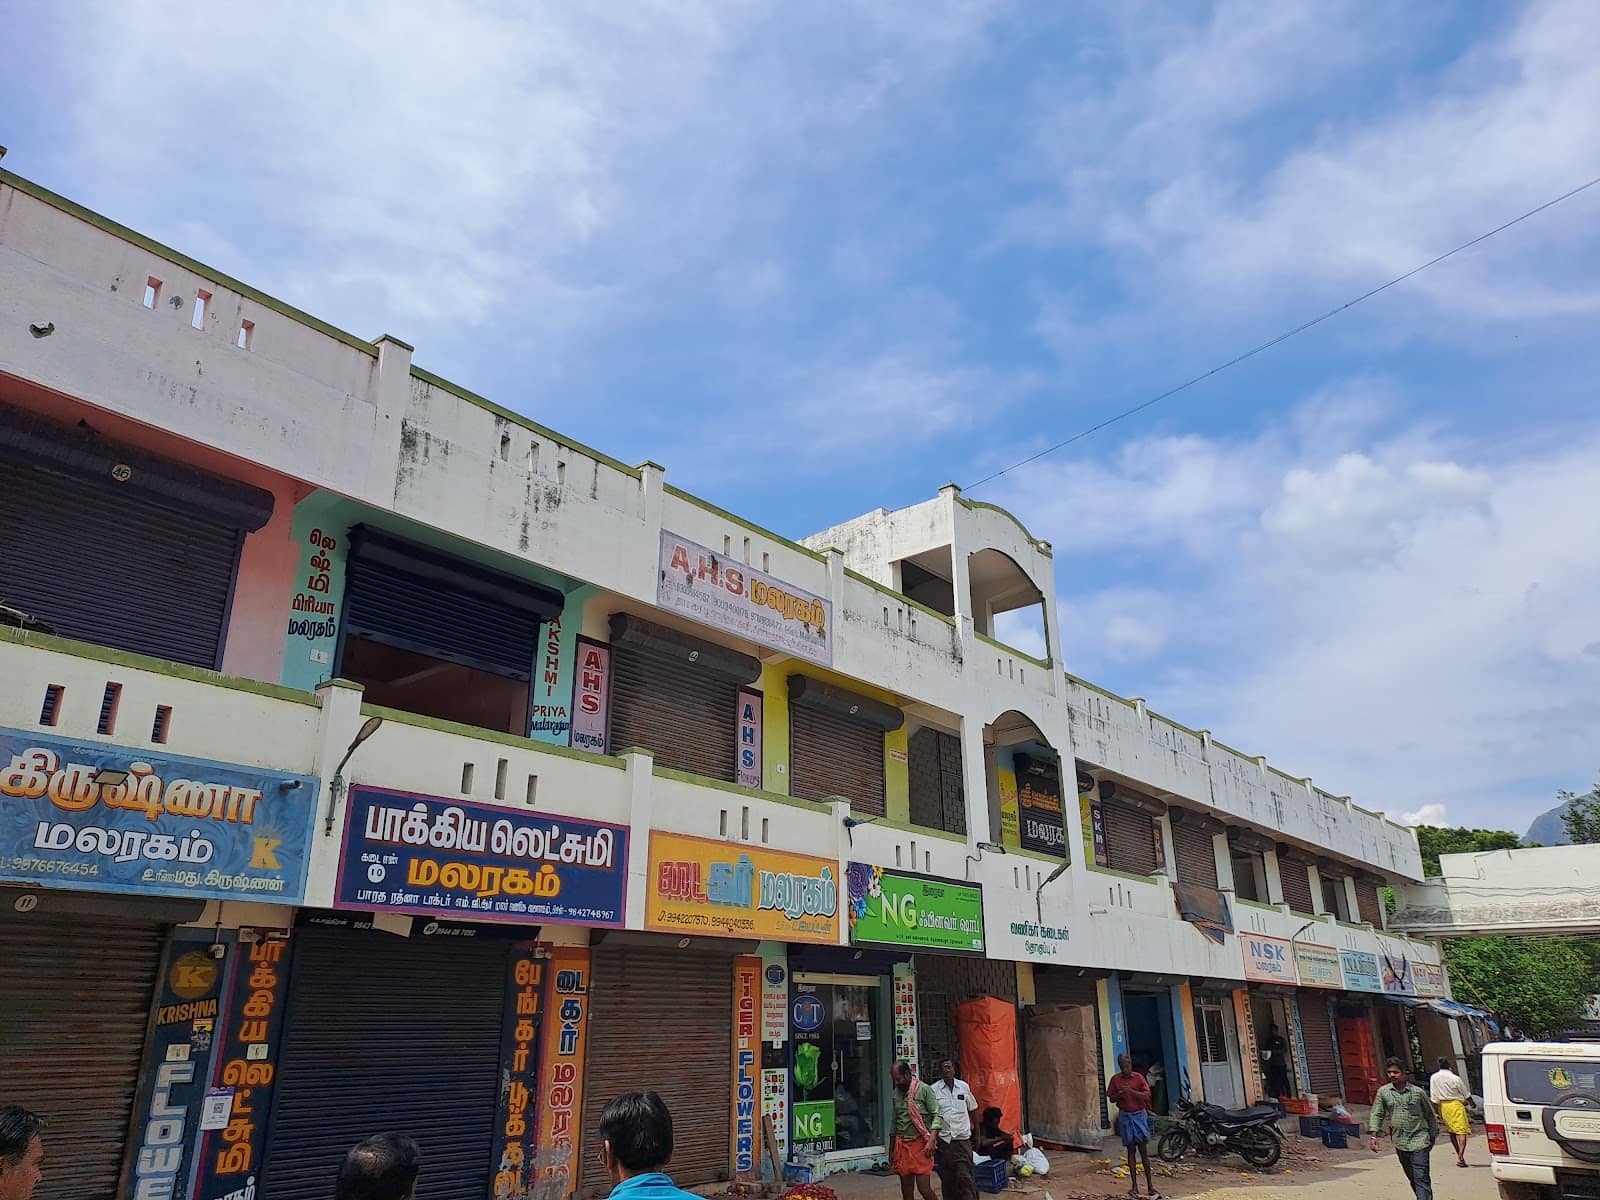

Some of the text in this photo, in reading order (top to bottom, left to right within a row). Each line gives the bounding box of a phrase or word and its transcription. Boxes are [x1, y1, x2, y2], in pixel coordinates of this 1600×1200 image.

[291, 593, 335, 616] பிரியா
[287, 616, 336, 641] மலரகம்
[582, 650, 603, 715] AHS
[533, 705, 567, 718] PRIYA
[742, 704, 756, 768] AHS
[33, 821, 214, 864] மலரகம்
[364, 802, 613, 868] பாக்கிய லெட்சுமி
[1025, 820, 1066, 846] மலரக
[408, 857, 561, 899] மலரகம்
[757, 866, 838, 920] மலரகம்
[357, 889, 387, 904] பாரத
[390, 888, 420, 905] ரத்னா
[880, 892, 918, 930] NG
[1249, 941, 1287, 962] NSK
[173, 965, 213, 989] K
[157, 998, 219, 1026] KRISHNA
[738, 972, 753, 1038] TIGER
[736, 1050, 754, 1173] FLOWERS
[795, 1112, 822, 1139] NG
